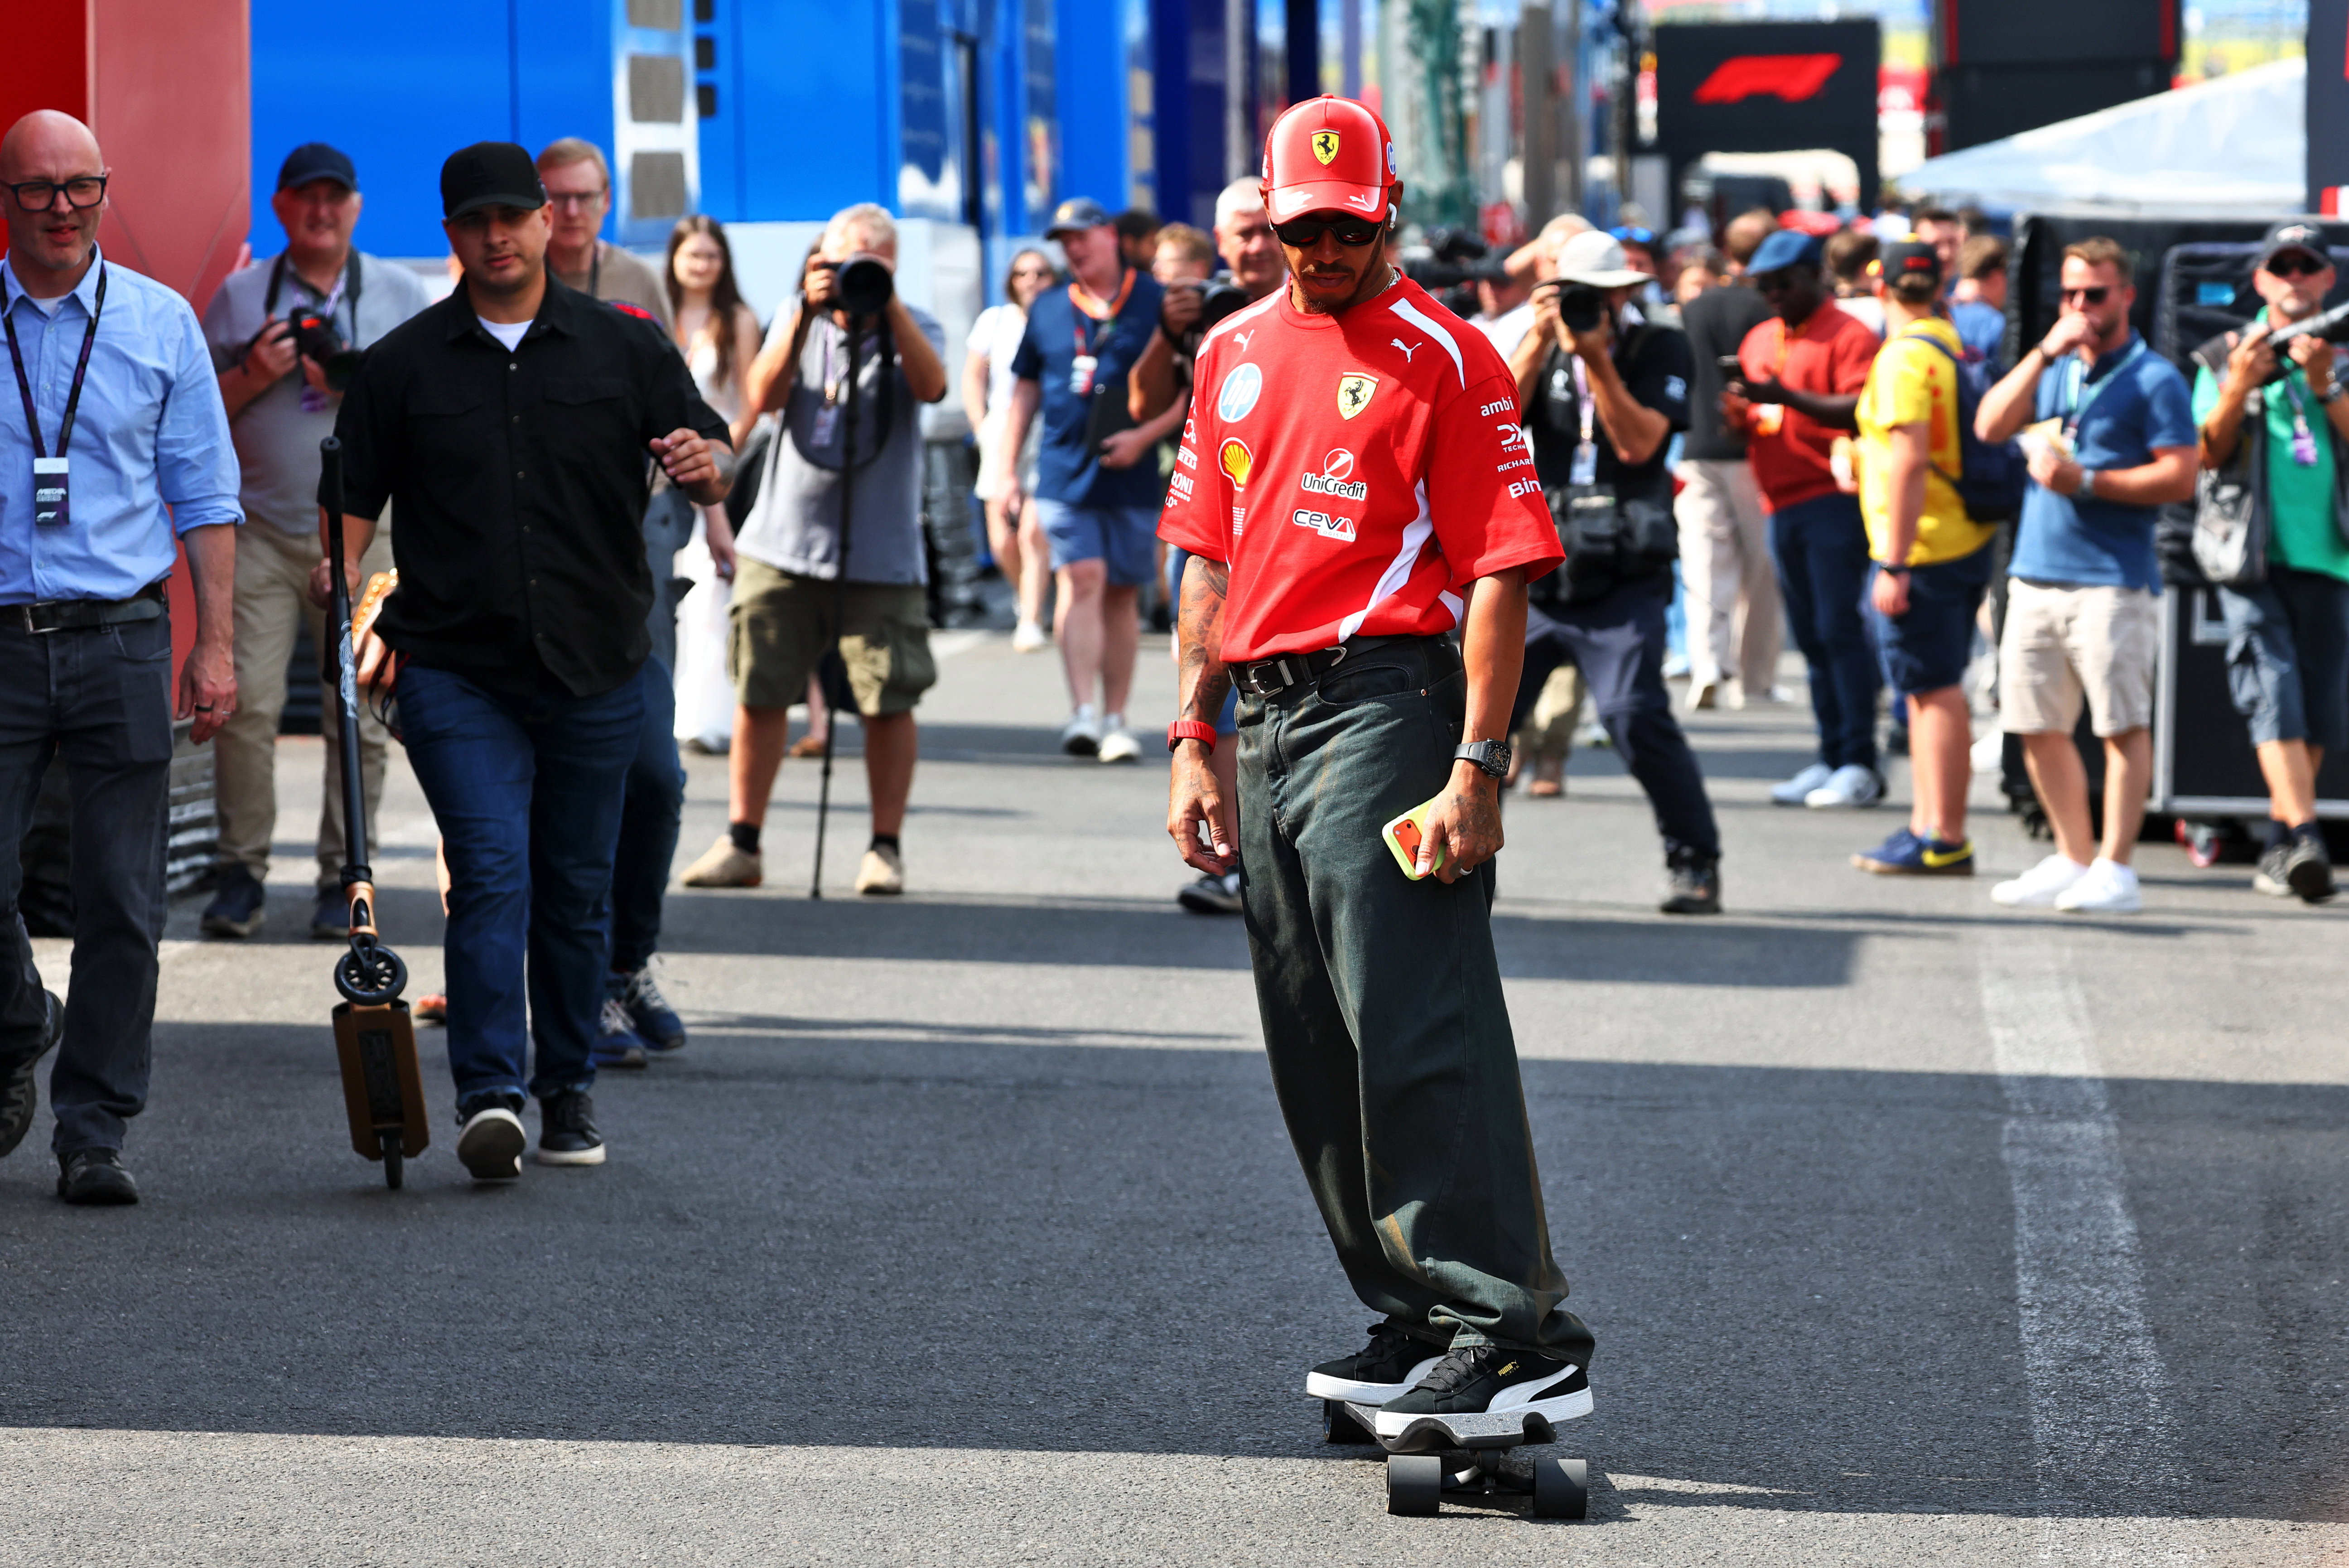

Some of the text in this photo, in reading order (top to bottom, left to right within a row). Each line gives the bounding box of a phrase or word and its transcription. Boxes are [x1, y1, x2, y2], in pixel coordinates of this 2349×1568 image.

[1222, 365, 1259, 420] hp
[1177, 445, 1197, 470] ELLI
[1302, 473, 1365, 499] UniCredit
[1319, 529, 1354, 540] LOGISTICS
[1497, 1363, 1513, 1377] PUMA
